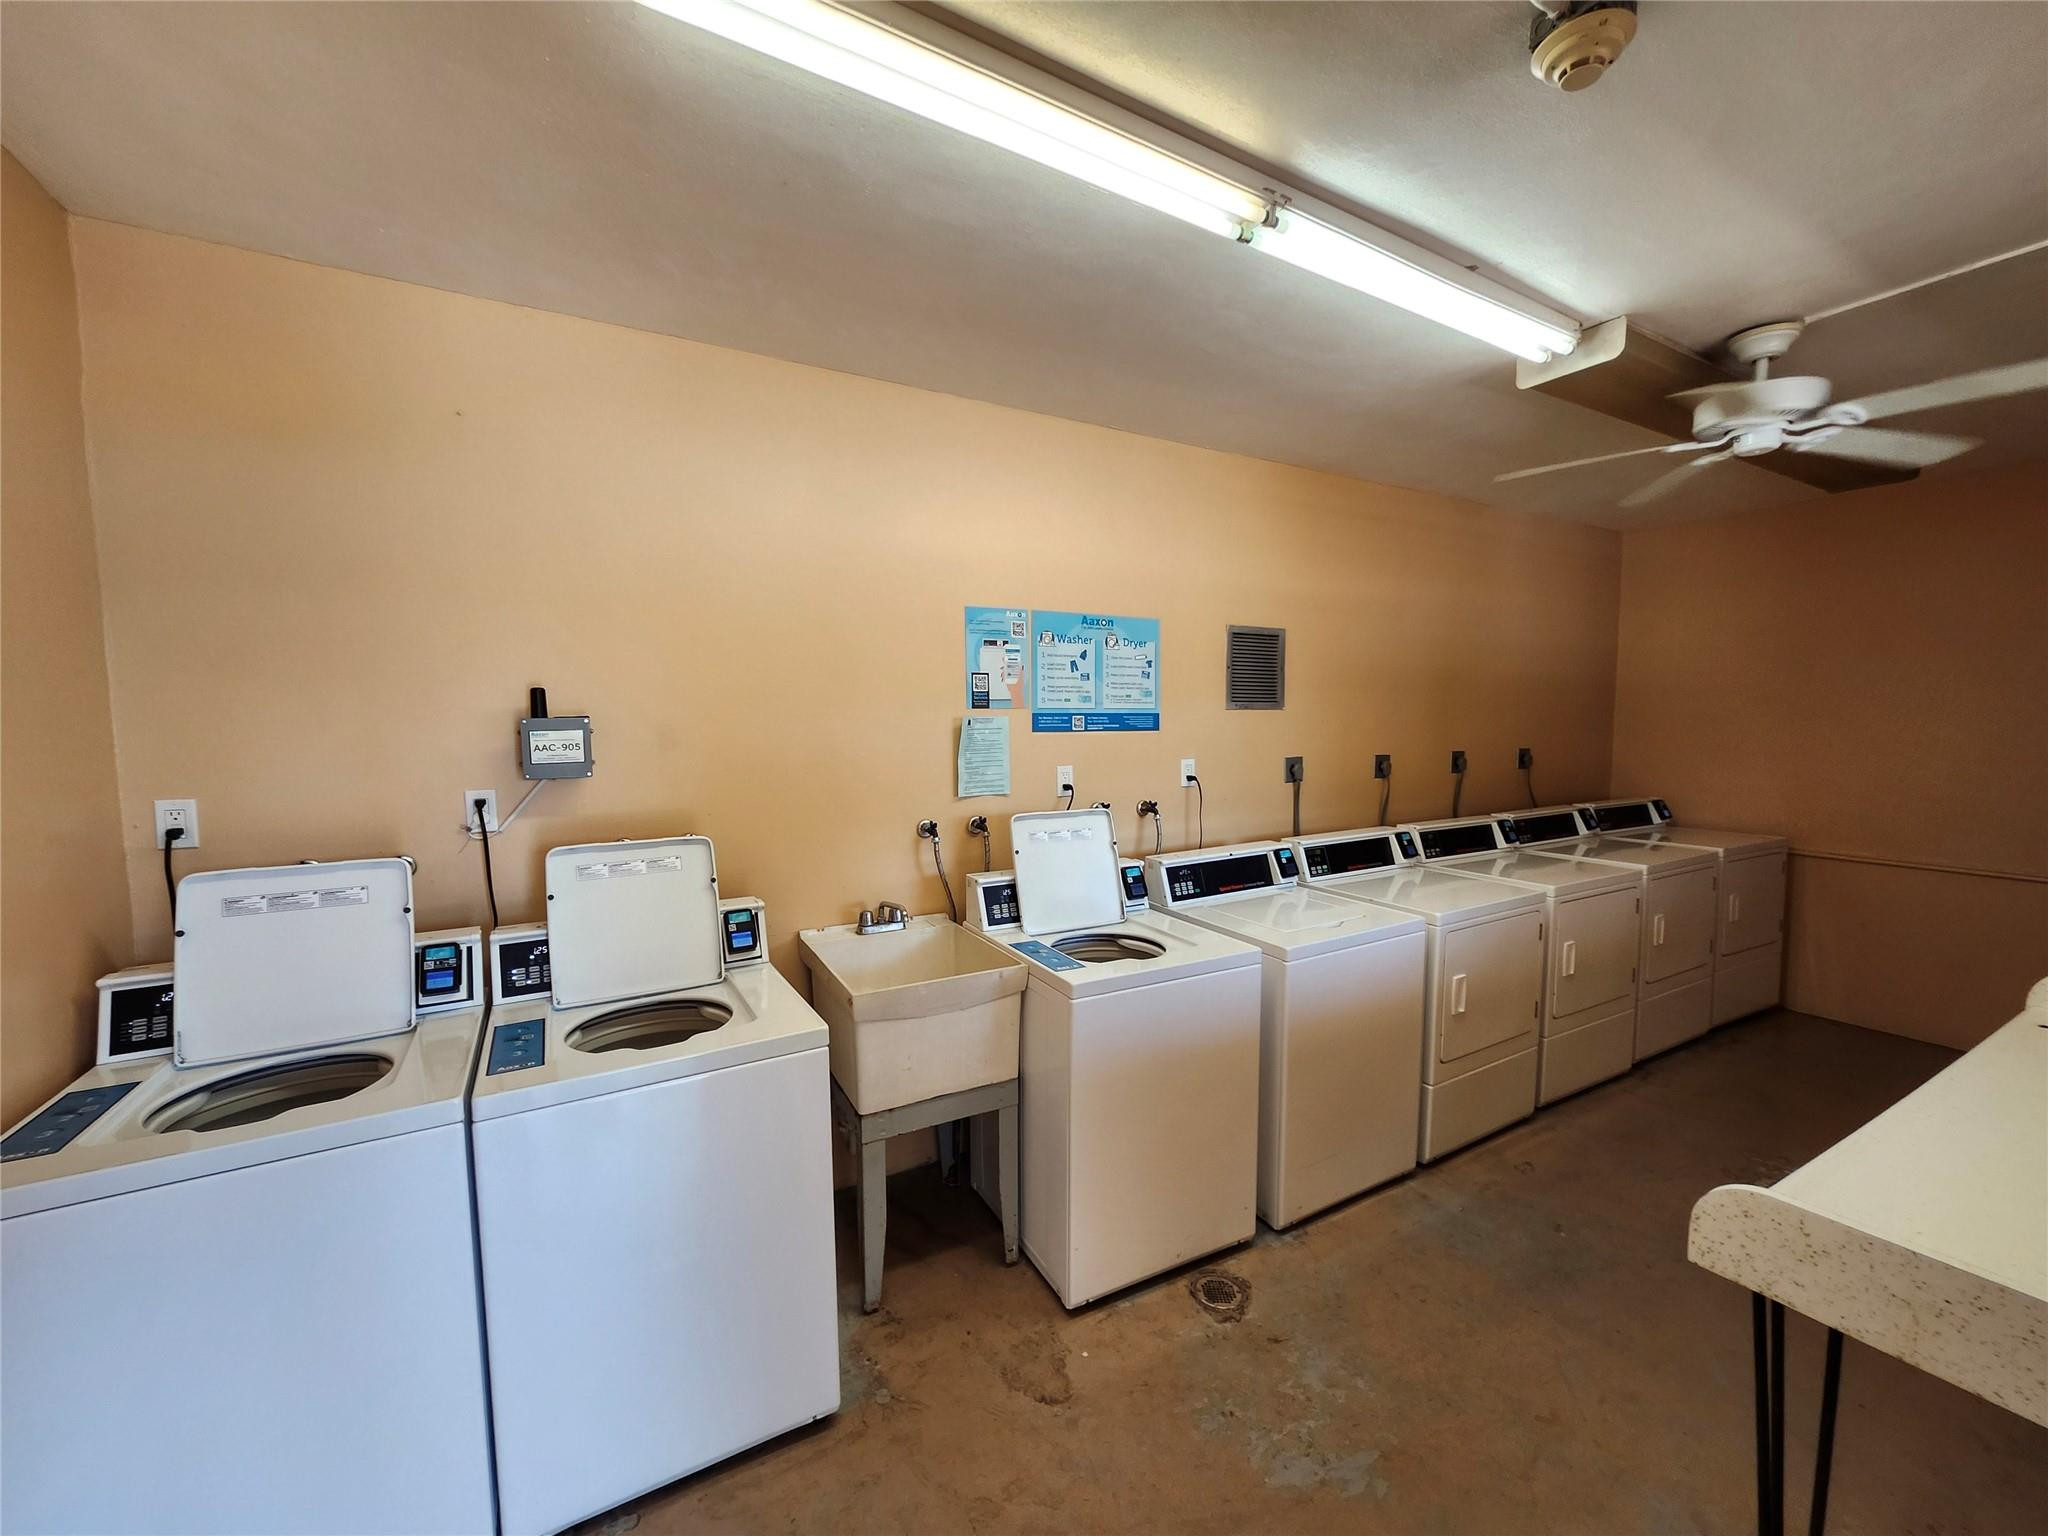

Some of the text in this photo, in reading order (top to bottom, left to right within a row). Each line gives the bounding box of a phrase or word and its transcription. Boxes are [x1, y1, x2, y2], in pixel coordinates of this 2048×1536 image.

[1081, 615, 1114, 628] Aaxon
[1056, 633, 1093, 645] Washer
[1122, 637, 1148, 650] Dryer
[533, 743, 581, 752] AAC-905
